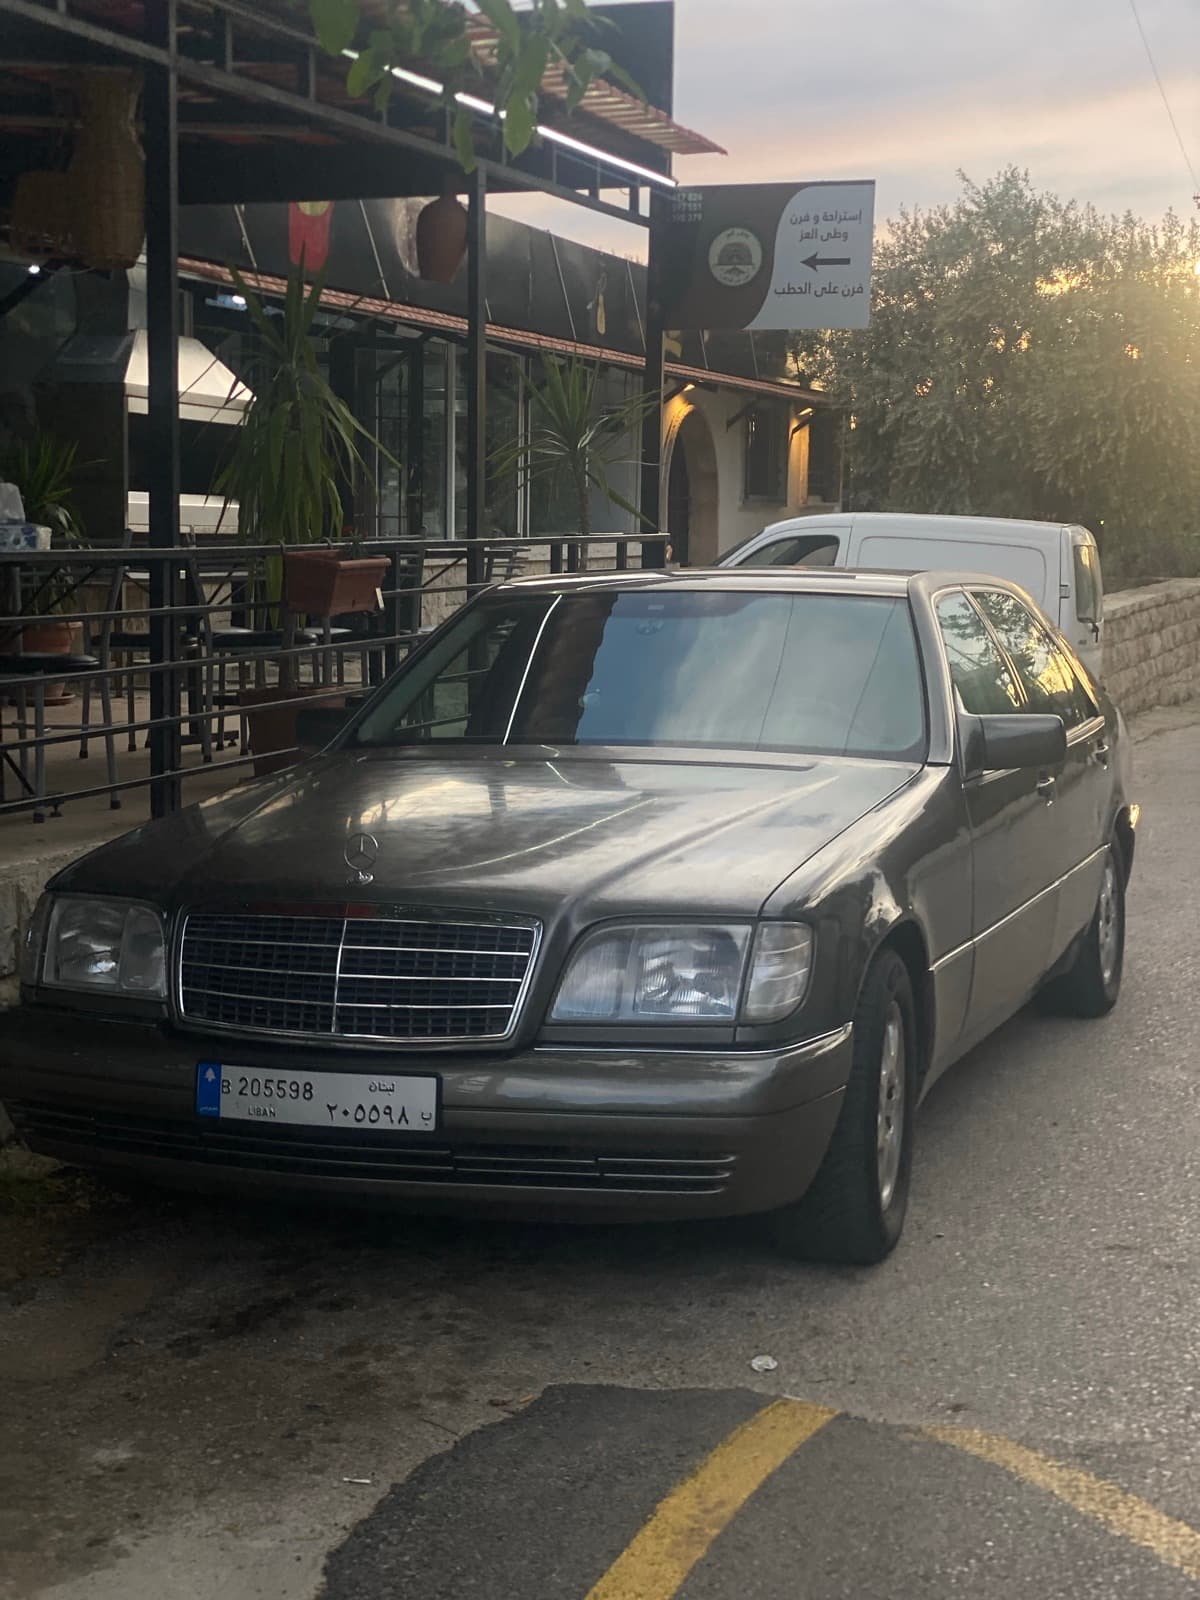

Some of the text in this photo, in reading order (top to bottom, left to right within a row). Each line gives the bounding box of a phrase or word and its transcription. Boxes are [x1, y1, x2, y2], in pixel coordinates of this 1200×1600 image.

[790, 209, 862, 225] إستراحة و فرن
[799, 228, 818, 242] العز
[774, 281, 864, 298] فرن على الحطب
[222, 1077, 314, 1101] B 205598
[368, 1081, 395, 1094] لبنان
[248, 1106, 276, 1118] LIBAN
[326, 1103, 432, 1126] ب ٢٠٥٥٩٨
